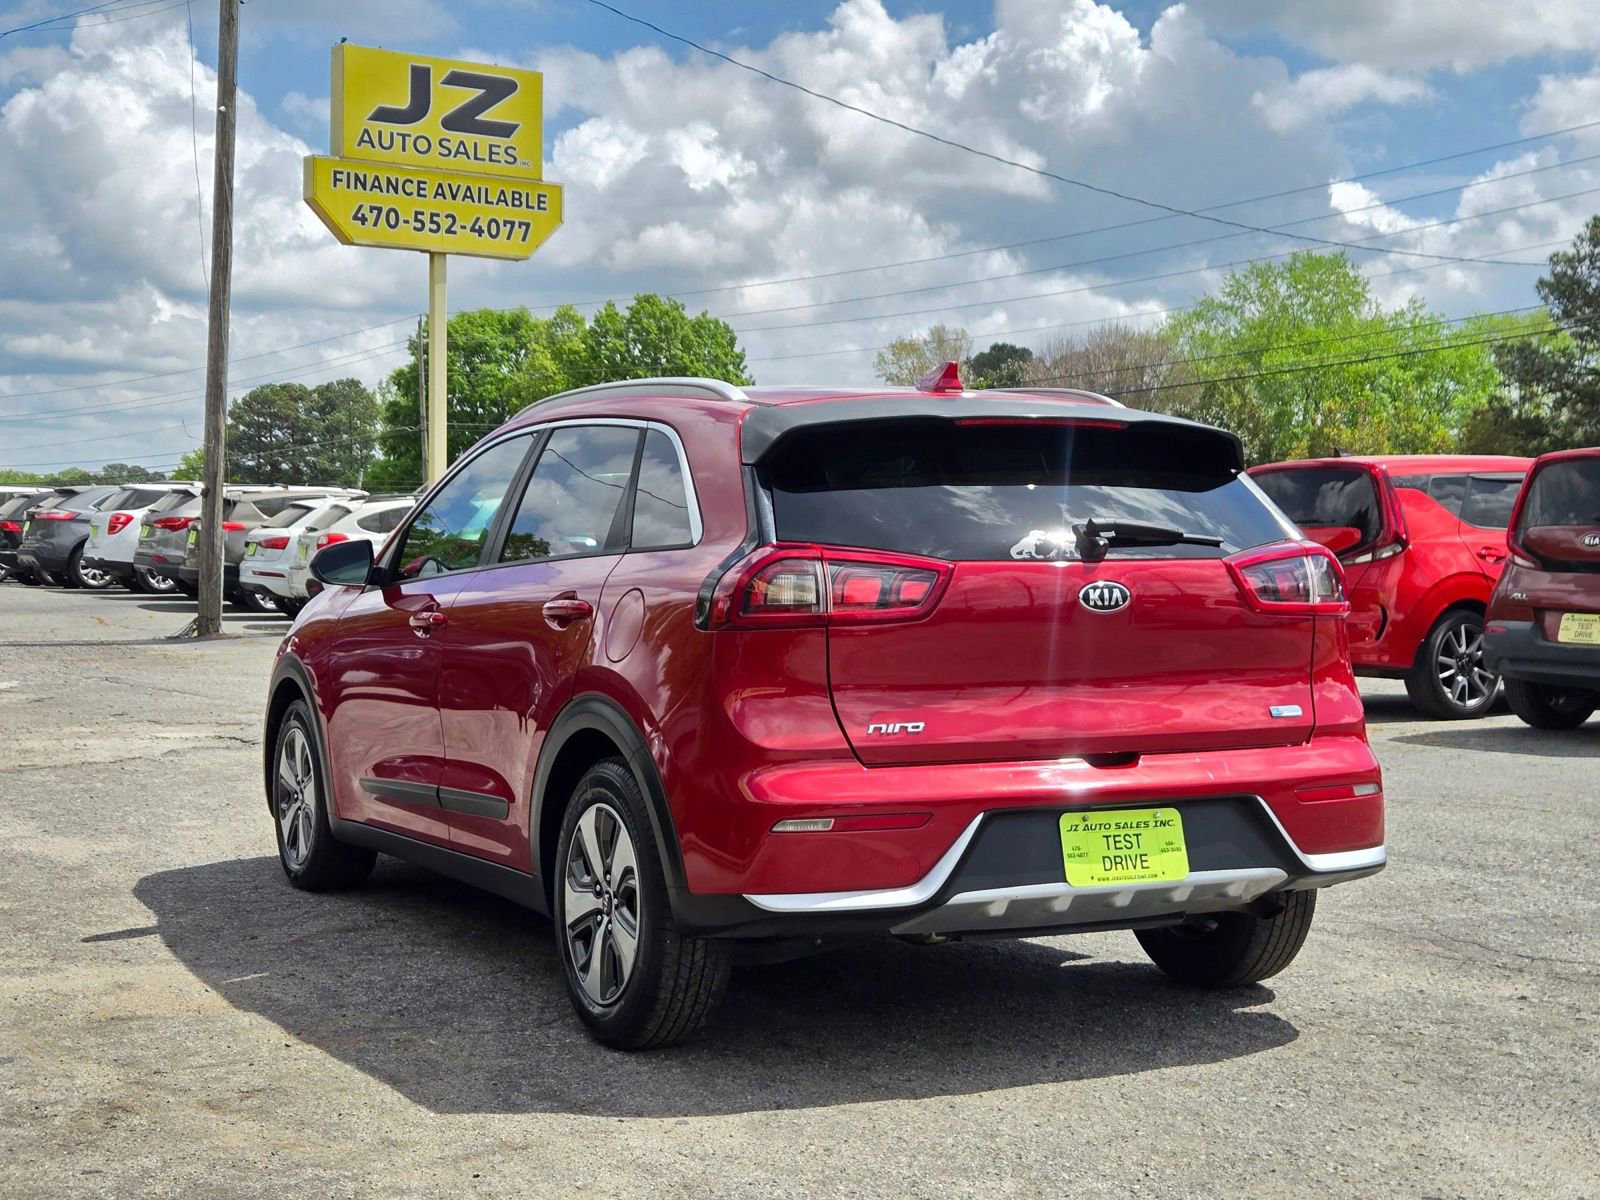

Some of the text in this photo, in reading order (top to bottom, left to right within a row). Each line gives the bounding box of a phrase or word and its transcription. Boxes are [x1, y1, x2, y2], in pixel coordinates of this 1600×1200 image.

[366, 64, 521, 138] JZ
[356, 128, 432, 156] AUTO
[438, 137, 518, 166] SALES
[332, 169, 548, 211] FINANCE AVAILABLE
[352, 204, 531, 243] 470-552-4077
[1584, 536, 1600, 545] KIA
[1088, 588, 1123, 606] KIA
[1066, 823, 1079, 832] JZ
[1083, 822, 1111, 832] AUTO
[1114, 820, 1150, 830] SALES
[1102, 833, 1142, 851] TEST
[1102, 853, 1150, 872] DRIVE
